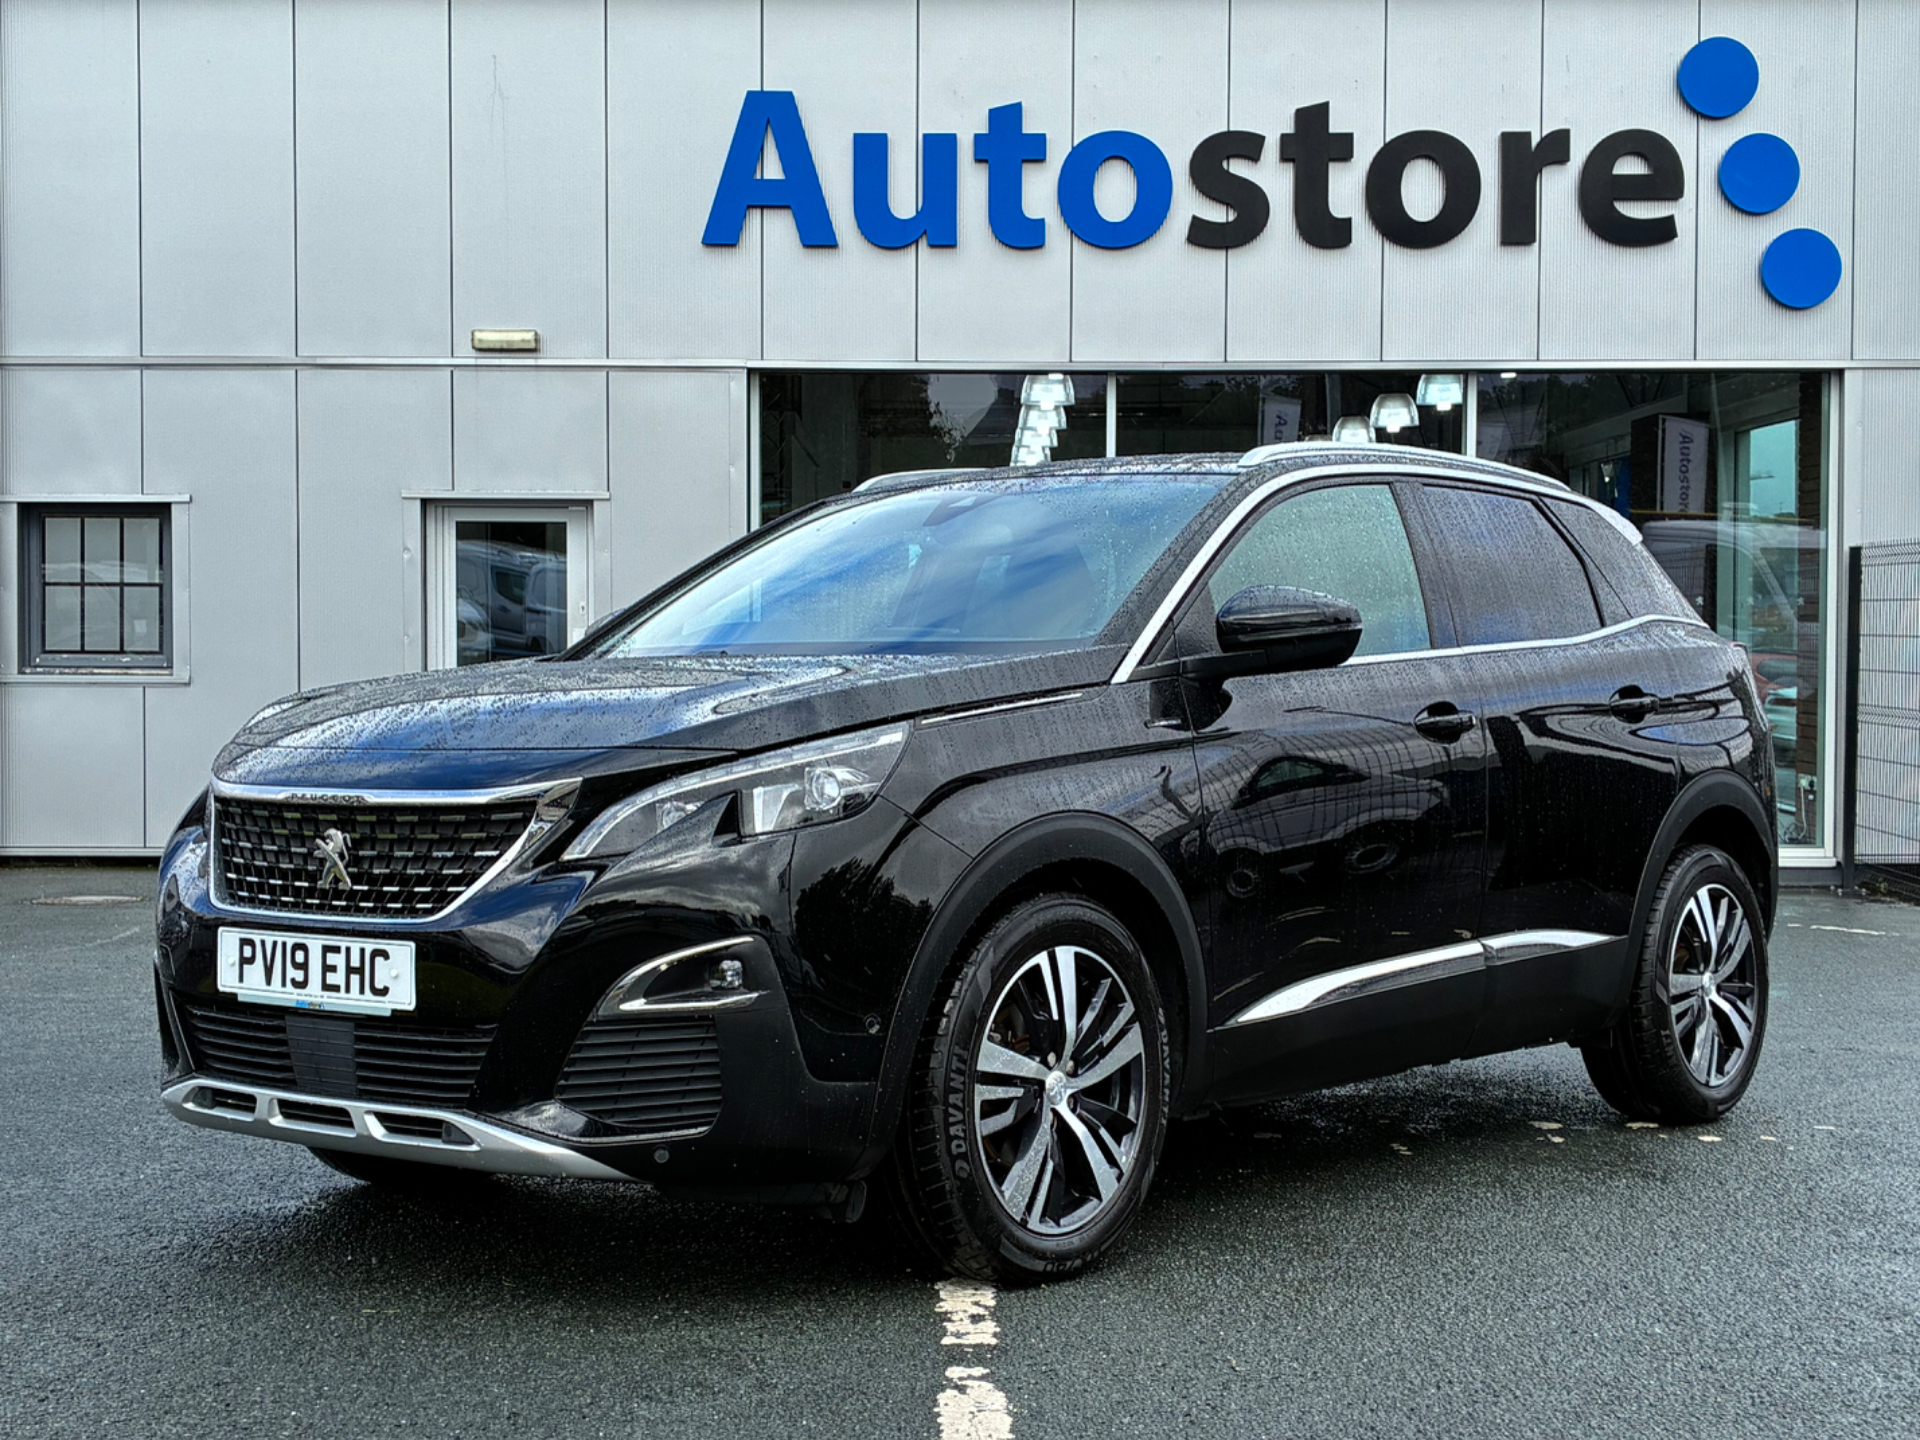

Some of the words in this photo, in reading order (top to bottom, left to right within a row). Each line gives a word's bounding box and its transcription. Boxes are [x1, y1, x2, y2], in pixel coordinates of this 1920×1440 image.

[702, 89, 1684, 249] Autostore
[291, 792, 363, 804] PEUGEOT
[238, 937, 309, 990] PV19
[320, 944, 391, 998] EHC
[948, 1045, 968, 1155] DAVANTI
